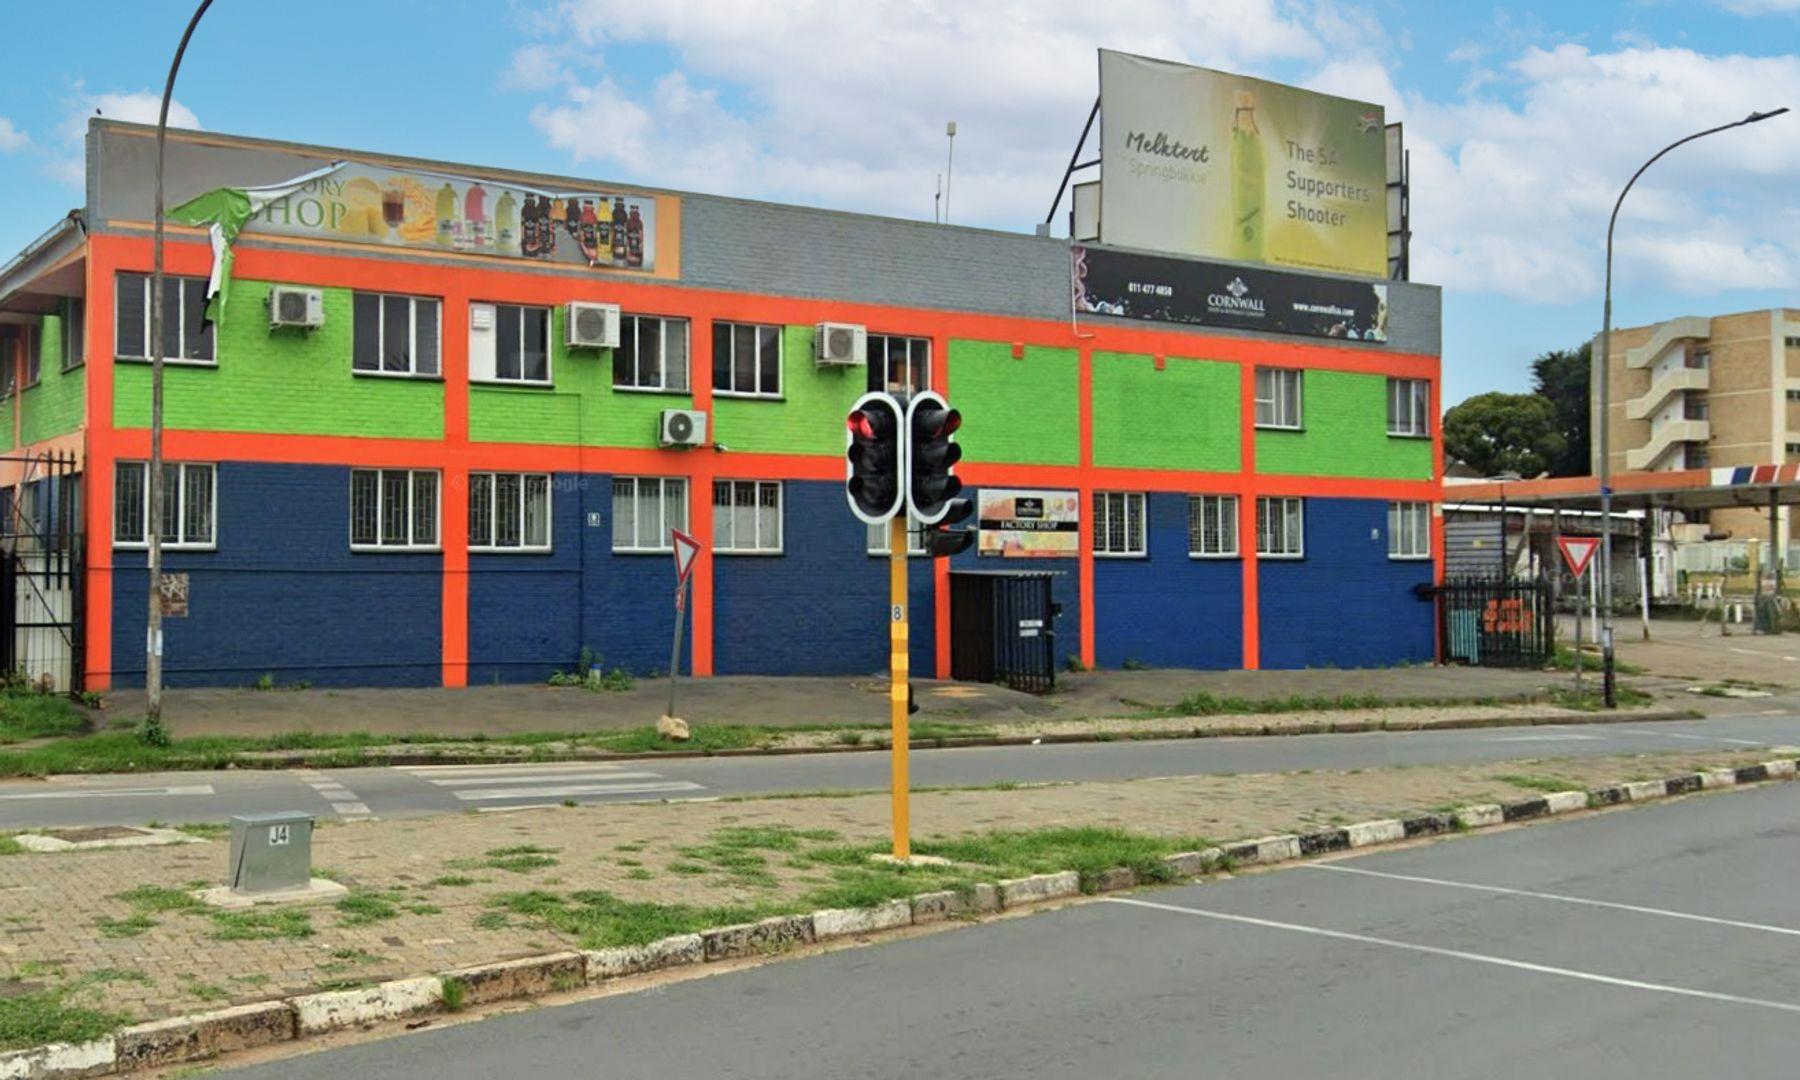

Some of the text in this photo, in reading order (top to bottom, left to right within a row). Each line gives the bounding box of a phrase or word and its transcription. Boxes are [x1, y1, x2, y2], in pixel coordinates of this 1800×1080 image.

[1125, 129, 1210, 164] Melktert
[1286, 140, 1315, 163] The
[1286, 169, 1370, 203] Supporters
[1286, 199, 1347, 228] Shooter
[1207, 294, 1266, 311] CORNWALL
[1000, 520, 1059, 531] FACTORY SHOP
[894, 606, 901, 620] 8
[271, 825, 287, 844] J4
